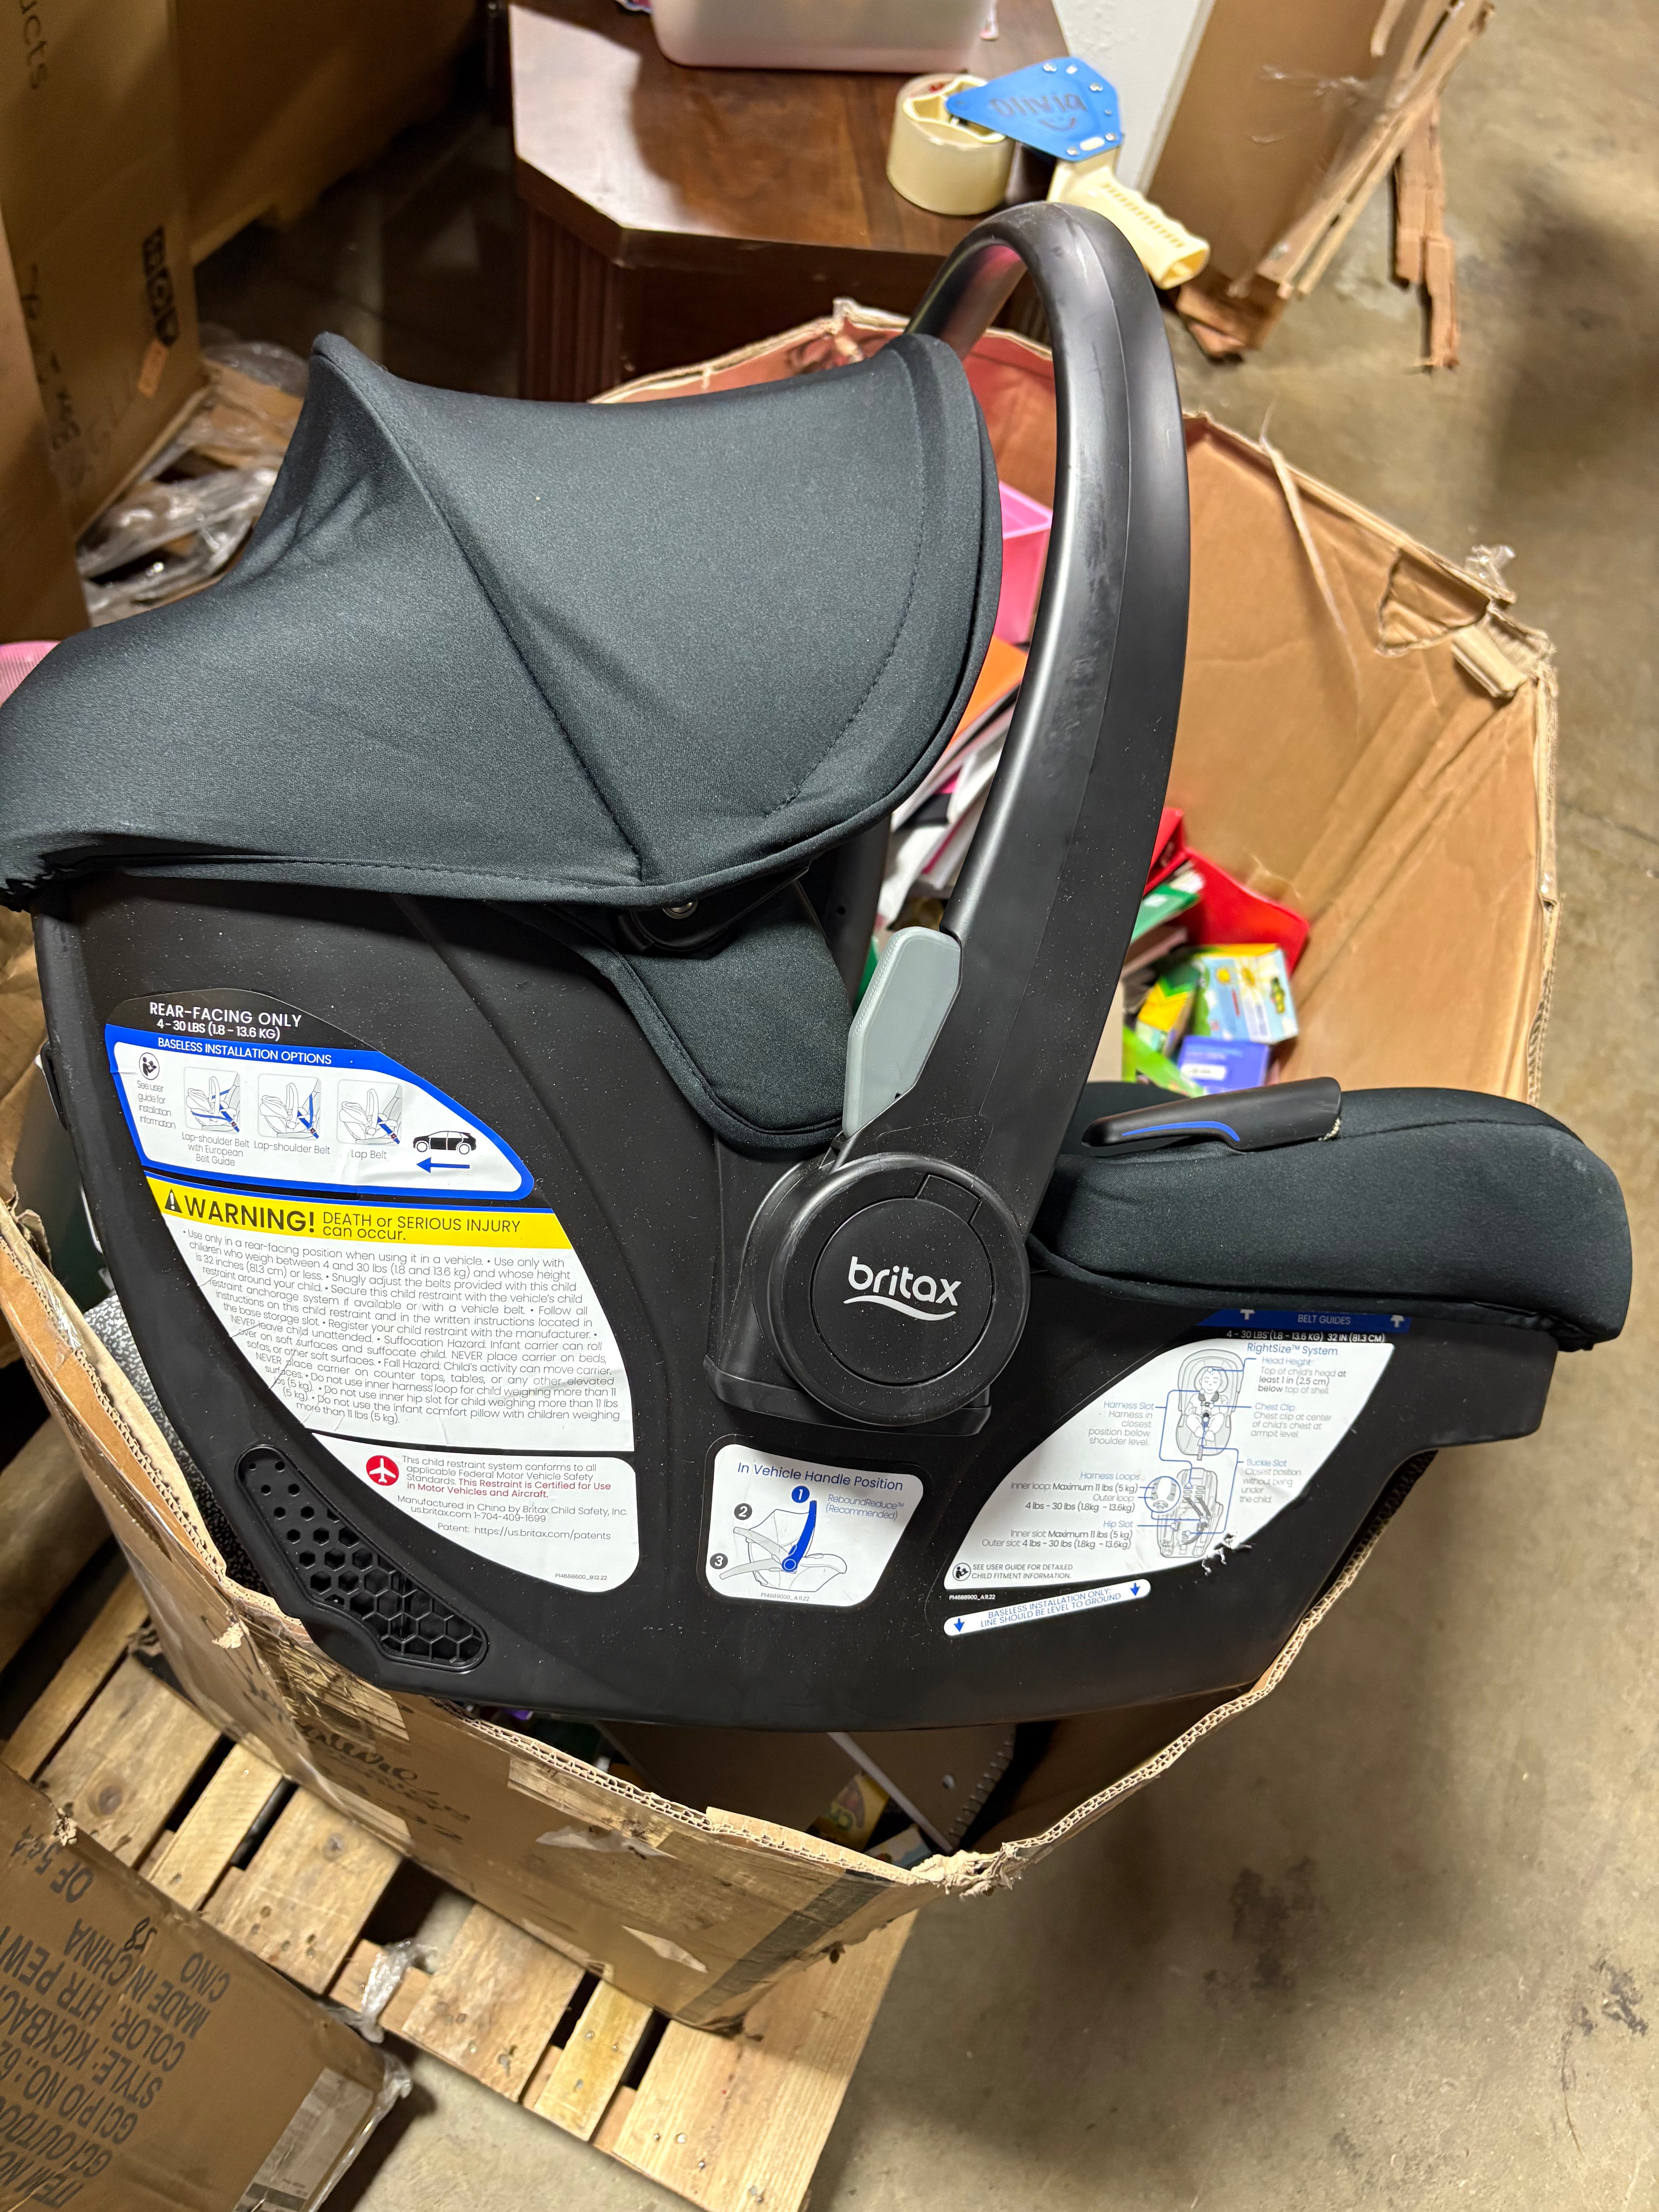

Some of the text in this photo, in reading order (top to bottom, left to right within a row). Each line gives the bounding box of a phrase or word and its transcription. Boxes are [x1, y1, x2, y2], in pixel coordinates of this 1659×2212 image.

[149, 1002, 302, 1027] REAR-FACING ONLY
[156, 1018, 164, 1029] 4
[173, 1020, 186, 1031] 30
[188, 1022, 205, 1033] LBS
[208, 1021, 225, 1036] (1.8
[236, 1026, 256, 1037] 13.6
[259, 1026, 280, 1041] KG)
[158, 1037, 331, 1064] BASELESS INSTALLATION OPTIONS
[182, 1132, 249, 1148] Lap-shoulder Belt
[254, 1140, 330, 1154] Lap-shoulder Belt
[196, 1153, 235, 1166] Belt Guide
[205, 1145, 243, 1158] European
[351, 1149, 386, 1160] Lap Belt
[184, 1195, 315, 1233] WARNING!
[323, 1212, 520, 1232] DEATH or SERIOUS INJURY
[323, 1226, 405, 1240] can occur.
[188, 1229, 202, 1240] Use
[205, 1235, 222, 1246] only
[245, 1242, 299, 1257] rear-facing
[303, 1249, 342, 1258] position
[346, 1250, 374, 1261] when
[379, 1254, 407, 1265] using
[411, 1254, 417, 1262] it
[444, 1255, 483, 1265] vehicle.
[495, 1257, 514, 1266] Use
[517, 1257, 539, 1269] only
[543, 1258, 564, 1267] with
[189, 1241, 570, 1281] children who weigh between 4 and 30 lbs (1.8 and 13.6 kg) and whose height
[848, 1256, 961, 1306] britax
[1298, 1314, 1350, 1325] BELT GUIDES
[1302, 1345, 1338, 1357] System
[1255, 1402, 1295, 1413] Chest Clip
[402, 1455, 419, 1464] This
[422, 1458, 444, 1466] child
[447, 1461, 485, 1469] restraint
[488, 1463, 522, 1471] system
[407, 1466, 456, 1476] applicable
[459, 1469, 494, 1478] Federal
[563, 1472, 593, 1482] Safety
[407, 1473, 456, 1485] Standards.
[480, 1479, 522, 1488] Restraint
[738, 1462, 903, 1491] In Vehicle Handle Position
[418, 1483, 445, 1492] Motor
[447, 1486, 487, 1496] Vehicles
[398, 1495, 464, 1509] Manufactured
[477, 1503, 505, 1512] China
[508, 1504, 520, 1515] by
[523, 1505, 548, 1513] Britax
[551, 1506, 575, 1514] Child
[578, 1507, 608, 1517] Safety,
[411, 1506, 546, 1522] us.britax.com 1-704-409-1699
[739, 1506, 747, 1517] 2
[826, 1502, 898, 1521] (Recommended)
[438, 1523, 611, 1540] Patent: https://us.britax.com/patents
[714, 1556, 723, 1566] 3
[981, 1618, 997, 1627] LINE
[1000, 1611, 1033, 1623] SHOULD
[1036, 1608, 1044, 1616] BE
[1047, 1604, 1069, 1614] LEVEL
[1085, 1593, 1121, 1606] GROUND
[988, 1588, 1111, 1618] BASELESS INSTALLATION ONLY:
[50, 1861, 94, 1903] OF
[64, 1918, 210, 2039] MADE IN CHINA
[57, 1972, 111, 2026] HTR
[0, 1985, 163, 2109] STYLE: KICKBAC
[110, 2005, 186, 2072] COLOR:
[58, 2084, 106, 2129] P/O
[93, 2102, 138, 2145] GCI
[63, 2140, 113, 2178] GCI
[14, 2166, 84, 2209] ITEM
